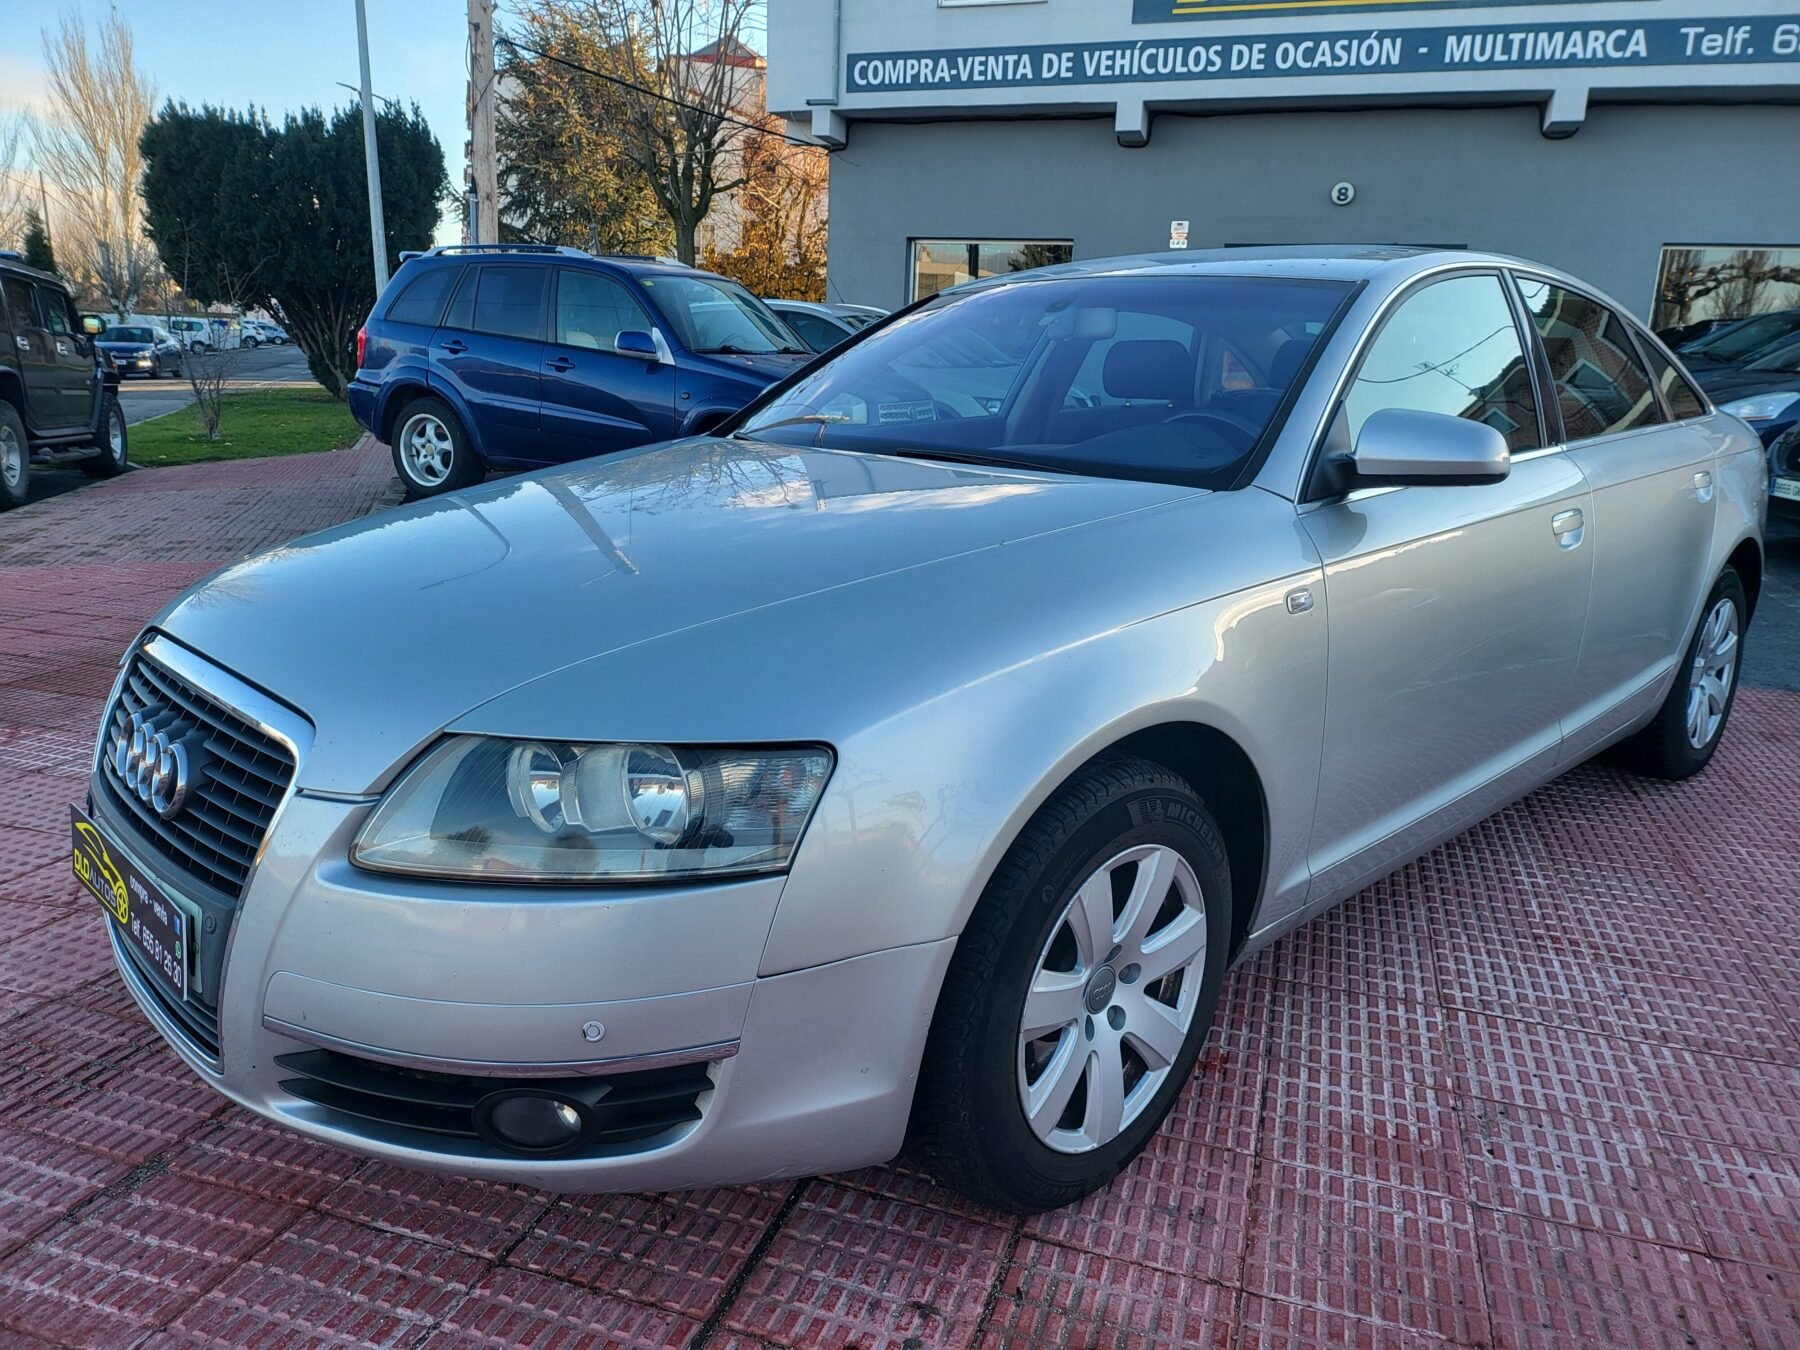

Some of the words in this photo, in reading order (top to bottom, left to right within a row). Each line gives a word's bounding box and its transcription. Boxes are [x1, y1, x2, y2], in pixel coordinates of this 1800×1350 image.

[853, 54, 1033, 86] COMPRA-VENTA
[1041, 52, 1075, 79] DE
[1083, 42, 1222, 77] VEHÍCULOS
[1230, 43, 1266, 71] DE
[1275, 31, 1402, 70] OCASIÓN
[1444, 29, 1648, 63] MULTIMARCA
[1680, 26, 1754, 56] Telf.
[1773, 23, 1800, 55] 6
[1336, 186, 1349, 202] 8
[142, 925, 154, 955] 655
[155, 939, 162, 965] 81
[164, 950, 173, 977] 26
[173, 961, 182, 988] 30
